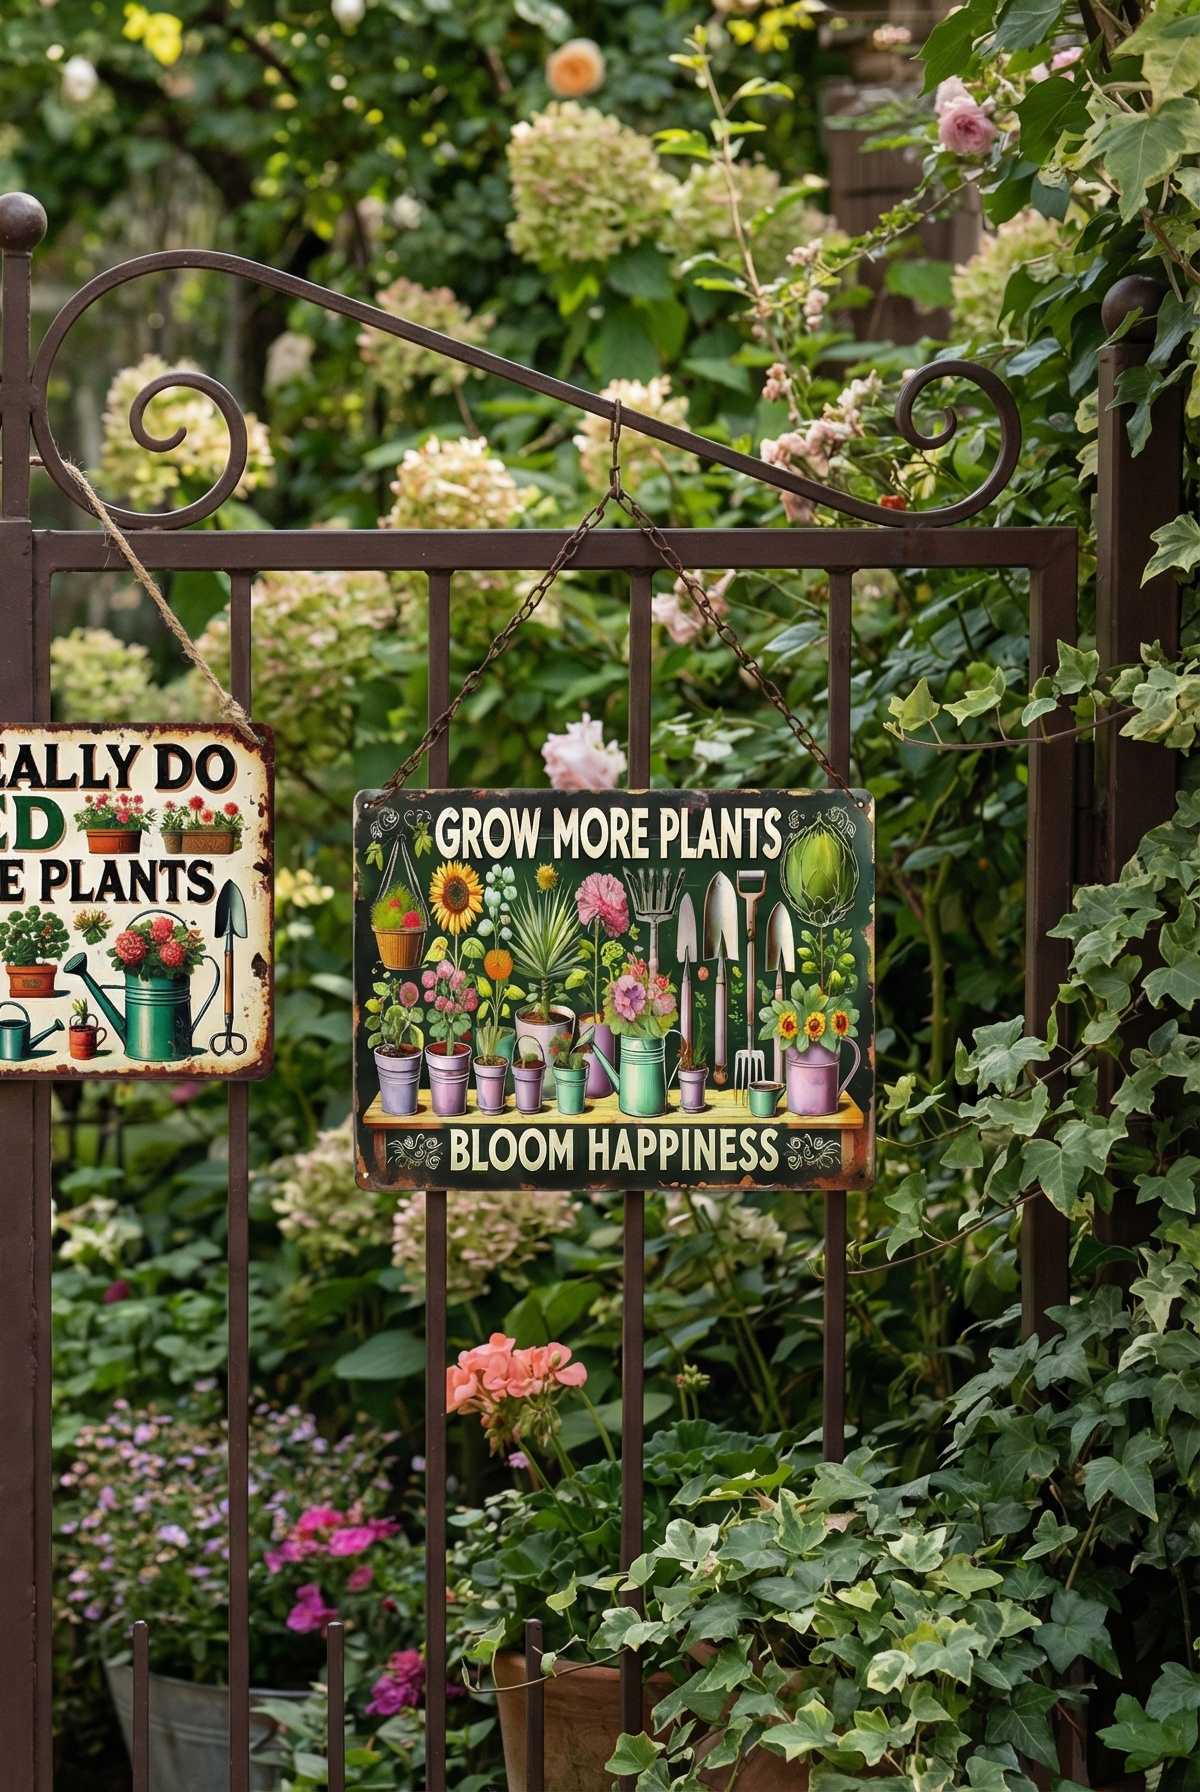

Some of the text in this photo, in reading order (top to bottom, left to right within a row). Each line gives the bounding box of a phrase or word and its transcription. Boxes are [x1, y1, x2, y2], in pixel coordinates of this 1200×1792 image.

[153, 744, 237, 791] DO
[435, 807, 783, 860] GROW MORE PLANTS
[40, 859, 215, 904] PLANTS
[450, 1128, 779, 1173] BLOOM HAPPINESS
